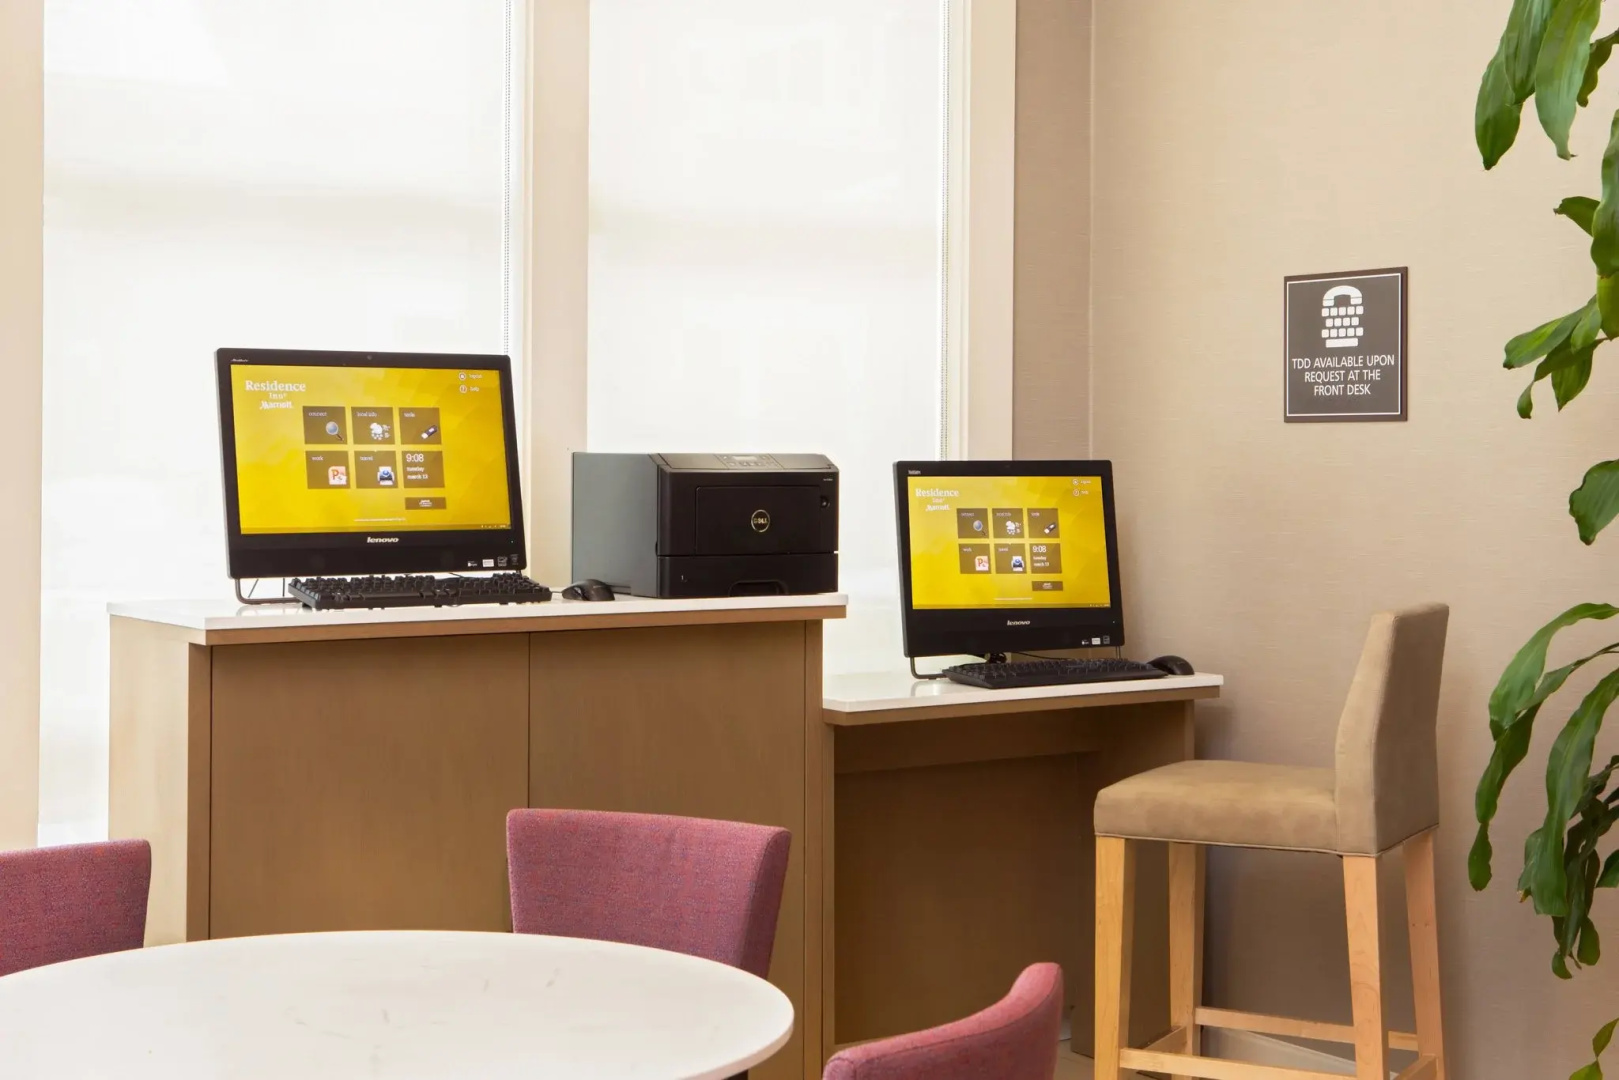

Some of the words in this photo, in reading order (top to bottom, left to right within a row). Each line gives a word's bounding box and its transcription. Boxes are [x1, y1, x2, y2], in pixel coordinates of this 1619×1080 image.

[1292, 358, 1311, 369] TDD
[1313, 355, 1364, 368] AVAILABLE
[1366, 354, 1395, 367] UPON
[1304, 370, 1345, 383] REQUEST
[1347, 369, 1360, 381] AT
[1362, 369, 1381, 380] THE
[245, 380, 306, 392] Residence
[1313, 384, 1344, 396] FRONT
[1347, 383, 1371, 395] DESK
[405, 453, 424, 463] 9:08
[915, 488, 959, 498] Residence
[366, 536, 399, 544] lenovo
